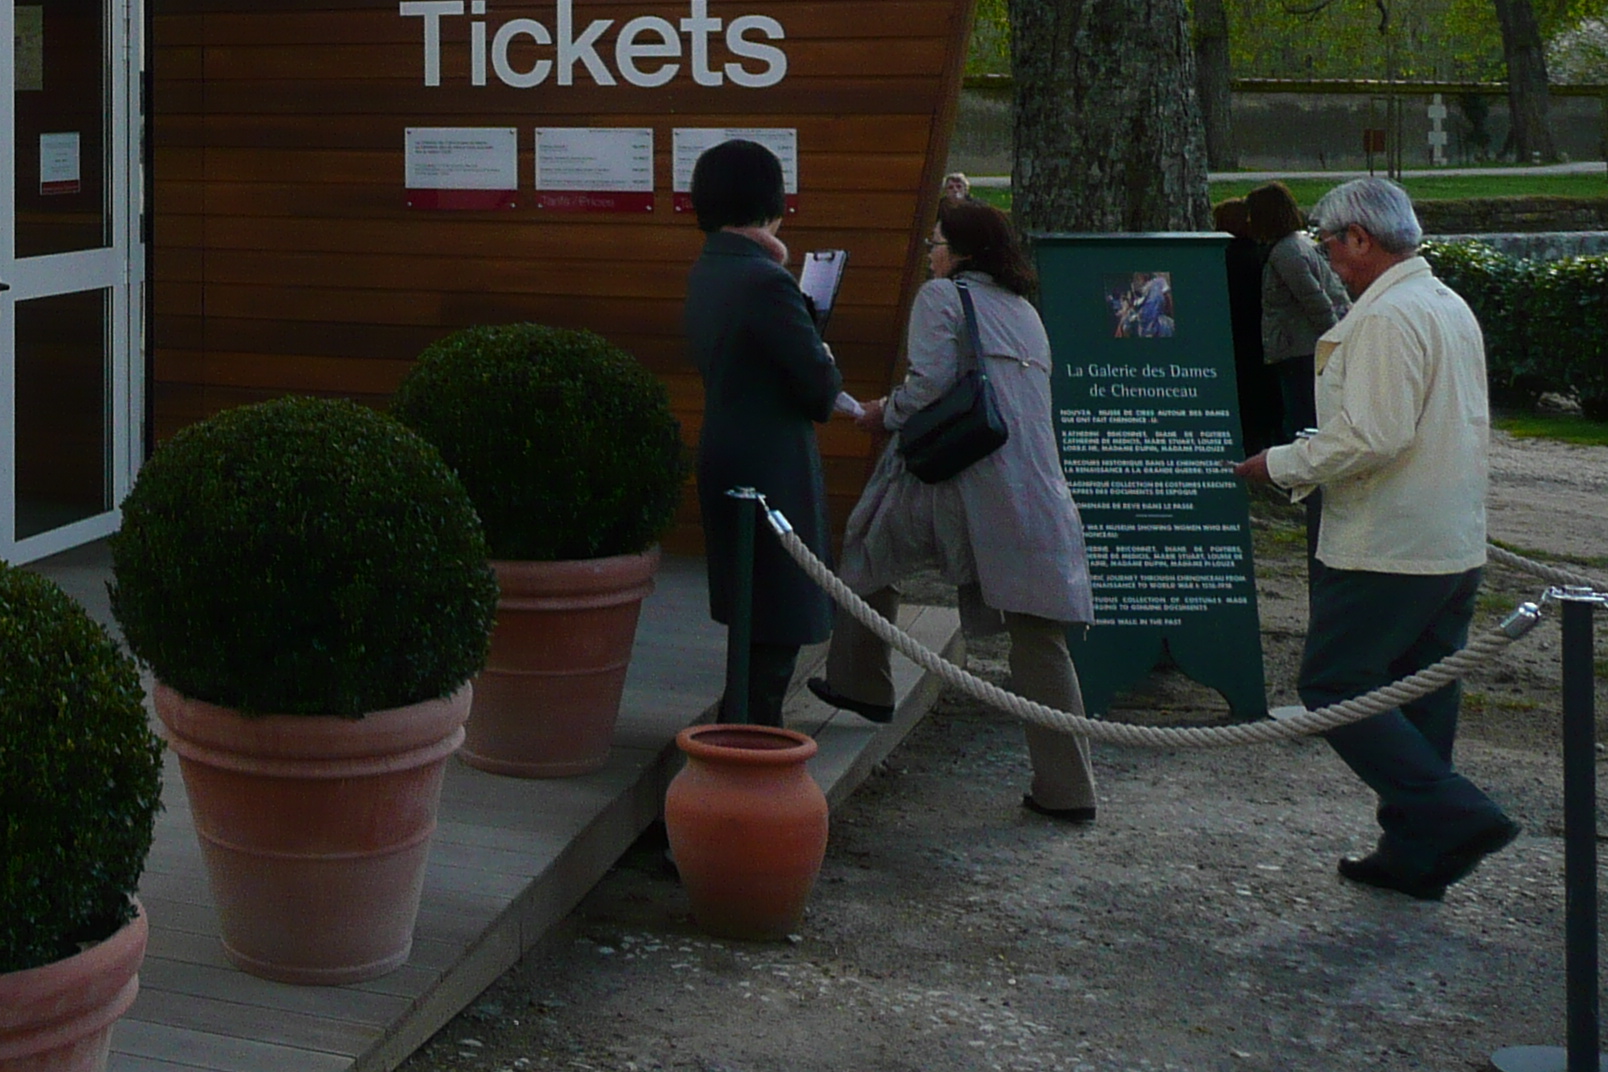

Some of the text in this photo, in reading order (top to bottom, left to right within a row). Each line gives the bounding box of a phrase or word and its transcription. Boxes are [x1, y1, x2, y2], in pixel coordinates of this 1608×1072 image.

[1066, 363, 1218, 378] La Galerie des Dames
[1089, 383, 1198, 398] de Chenonceau
